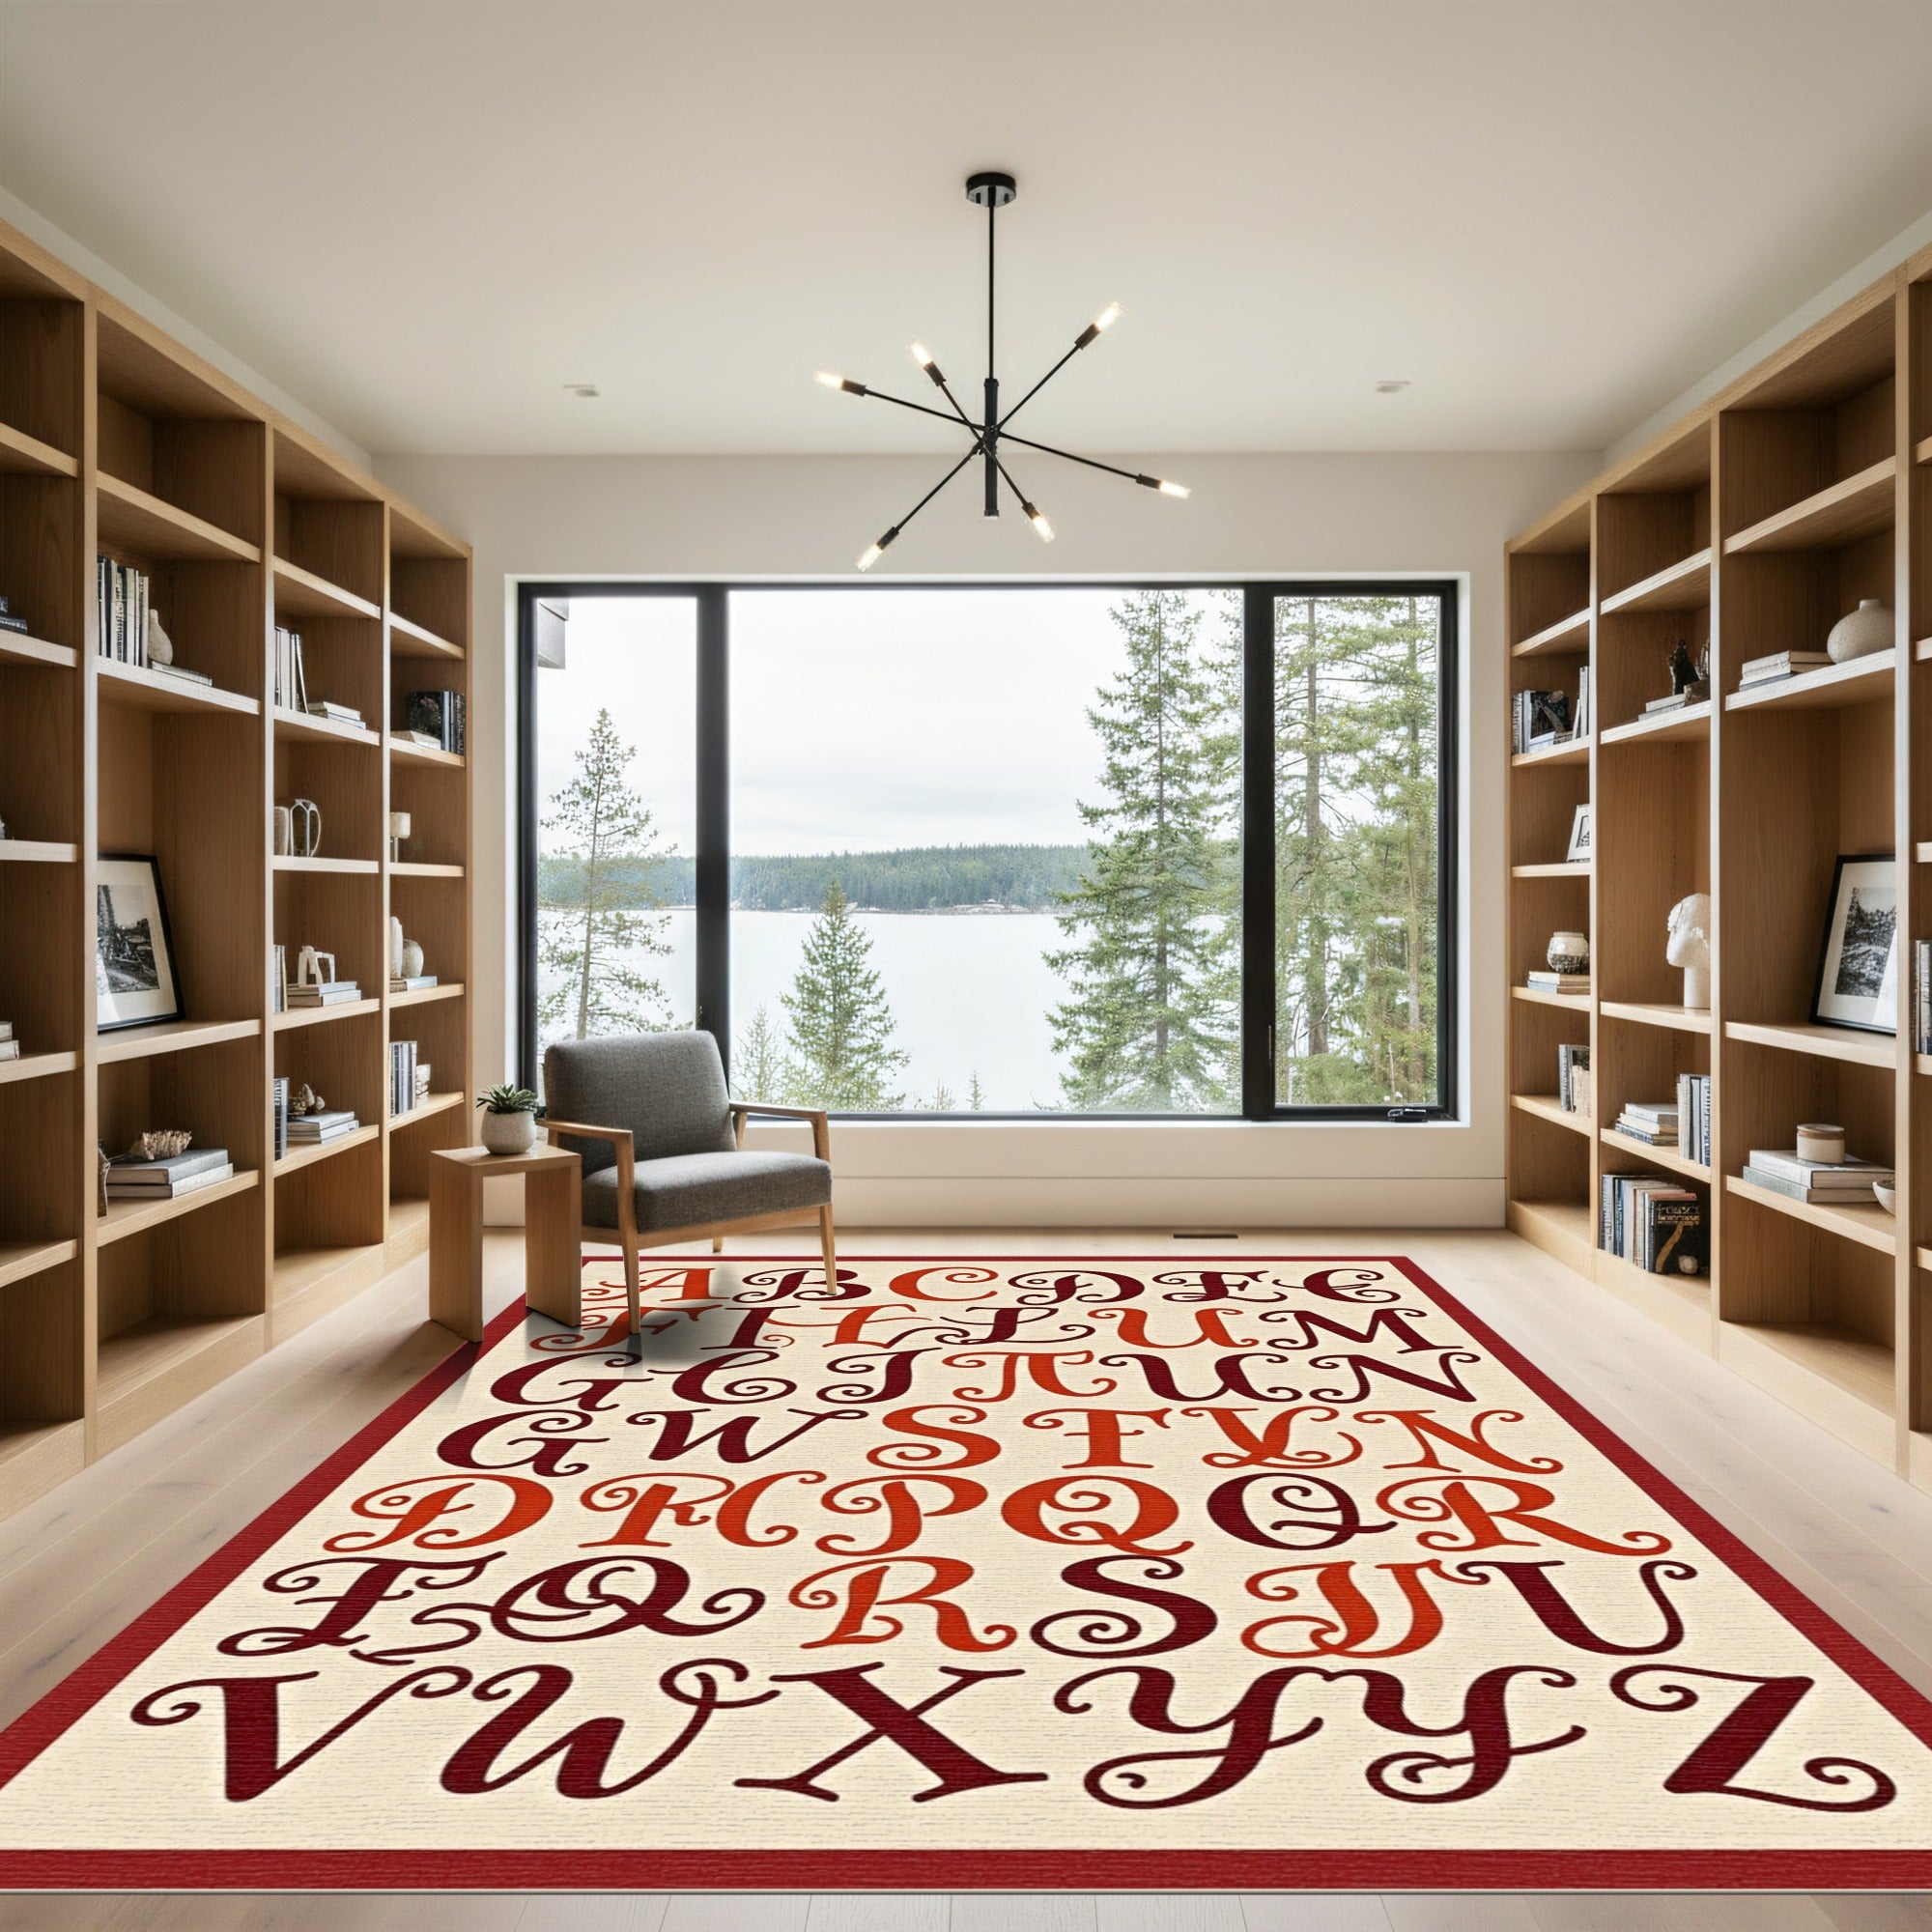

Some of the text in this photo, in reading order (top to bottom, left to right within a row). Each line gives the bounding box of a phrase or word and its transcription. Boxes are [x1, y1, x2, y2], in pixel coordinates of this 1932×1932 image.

[581, 1267, 730, 1302] A
[731, 1266, 872, 1304] B
[889, 1266, 999, 1302] C
[1008, 1270, 1146, 1305] D
[1087, 1307, 1261, 1350] U
[1258, 1307, 1463, 1354] M
[490, 1351, 655, 1412] G
[1309, 1351, 1481, 1404] N
[437, 1408, 611, 1478] G
[625, 1407, 869, 1464] W
[866, 1404, 1003, 1471] S
[1022, 1407, 1174, 1469] F
[1352, 1409, 1564, 1475] N
[323, 1473, 554, 1553] D
[814, 1473, 989, 1558] P
[1001, 1474, 1196, 1557] Q
[1206, 1472, 1399, 1550] Q
[1376, 1475, 1672, 1557] R
[788, 1555, 1017, 1653] R
[1030, 1554, 1219, 1660] S
[1456, 1559, 1698, 1658] U
[130, 1665, 473, 1802] V
[440, 1658, 779, 1800] W
[734, 1661, 1047, 1803] X
[1609, 1663, 1896, 1813] Z
